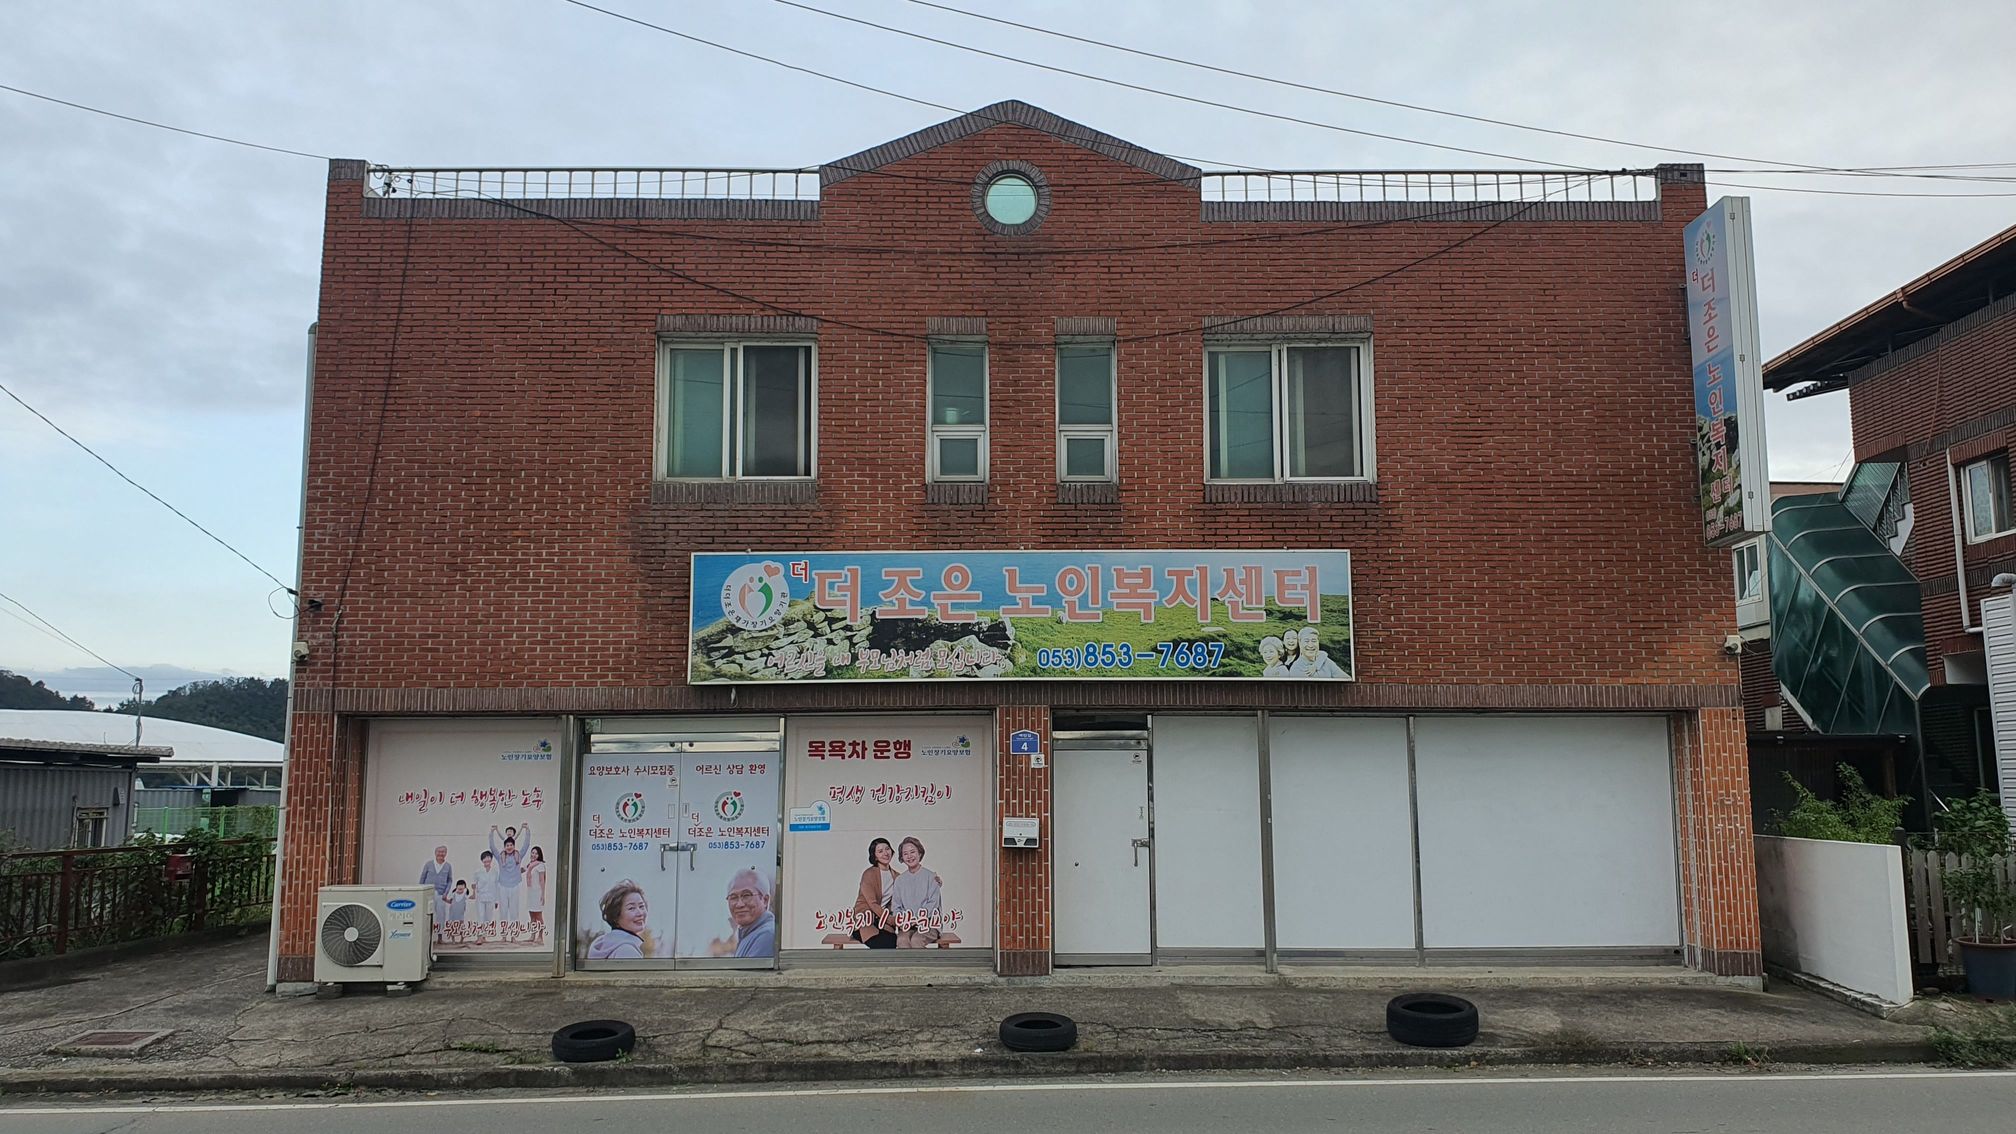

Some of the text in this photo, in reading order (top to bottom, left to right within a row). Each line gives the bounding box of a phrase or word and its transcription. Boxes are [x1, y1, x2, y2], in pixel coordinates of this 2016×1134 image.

[1692, 268, 1699, 284] 더
[1700, 267, 1719, 354] 더조은
[1706, 361, 1734, 504] 노인복지센터
[791, 562, 809, 582] 더
[815, 564, 1321, 624] 더조은 노인복지센터
[767, 649, 826, 677] 어르신을
[833, 652, 851, 667] 내
[856, 648, 932, 673] 부모님처럼
[1037, 642, 1225, 671] 053)853-7687
[808, 739, 912, 760] 목욕차 운행
[1021, 742, 1028, 751] 4
[588, 765, 675, 776] 요양보호사 수시모집중
[696, 764, 766, 775] 어르신 상담 환영
[399, 787, 543, 812] 내일이 더 행복한 노후
[829, 783, 952, 804] 평생 건강지킴이
[593, 814, 600, 823] 더
[692, 813, 699, 822] 더
[589, 827, 670, 838] 더조은 노인복지센터
[688, 826, 769, 837] 더조은 노인복지센터
[592, 842, 649, 851] 053)853-7687
[709, 841, 765, 850] 053)853-7687
[444, 920, 496, 939] 부모님처럼
[815, 910, 872, 936] 노인복지
[896, 909, 962, 933] 방문요양
